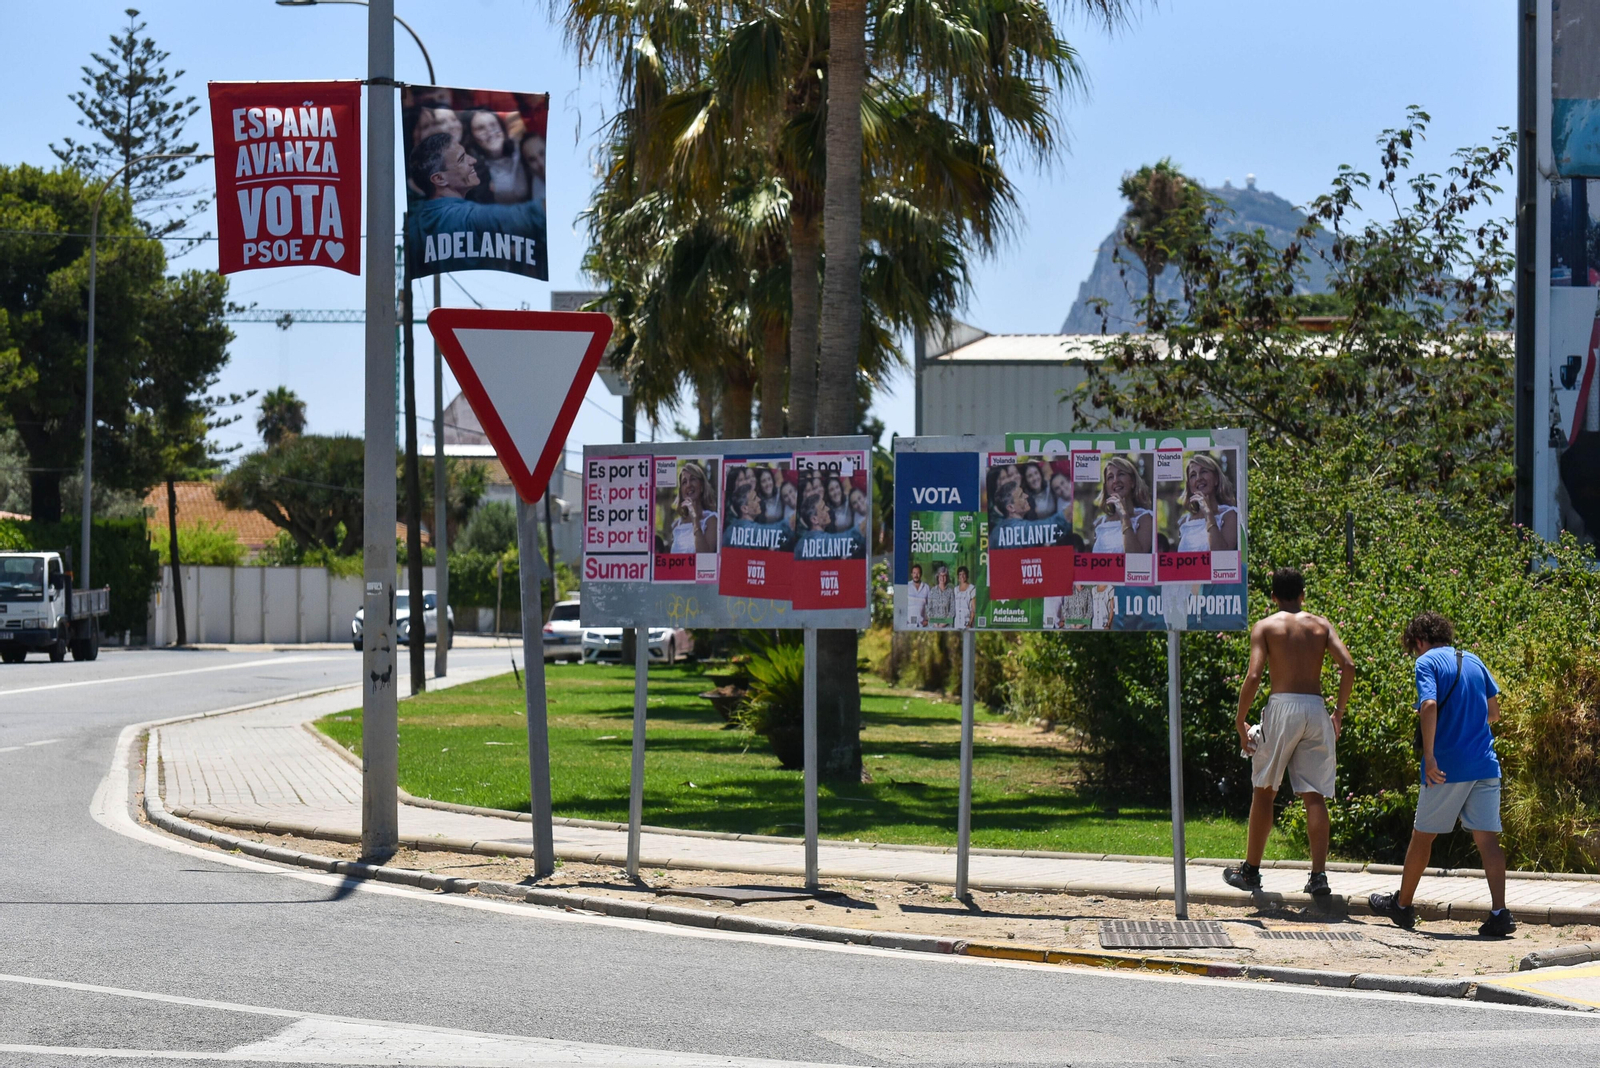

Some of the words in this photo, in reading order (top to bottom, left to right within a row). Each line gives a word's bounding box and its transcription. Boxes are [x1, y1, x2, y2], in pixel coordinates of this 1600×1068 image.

[232, 100, 337, 142] ESPAÑA
[235, 140, 339, 178] AVANZA
[237, 184, 344, 239] VOTA
[243, 239, 303, 265] PSOE
[424, 231, 537, 266] ADELANTE
[588, 462, 605, 478] Es
[609, 464, 634, 482] por
[638, 460, 649, 478] ti
[818, 461, 842, 471] po
[608, 486, 634, 504] por
[638, 482, 649, 500] ti
[912, 487, 962, 504] VOTA
[588, 505, 605, 522] Es
[608, 507, 634, 526] por
[637, 504, 648, 522] ti
[911, 520, 924, 531] EL
[587, 527, 604, 544] Es
[608, 529, 633, 548] por
[637, 526, 648, 544] ti
[730, 526, 783, 549] ADELANTE
[911, 531, 956, 542] PARTIDO
[998, 524, 1058, 547] ADELANTE
[802, 537, 854, 558] ADELANTE
[911, 542, 959, 553] ANDALUZ
[585, 557, 649, 580] Sumar
[655, 555, 667, 567] Es
[668, 557, 686, 569] por
[686, 555, 695, 567] ti
[1073, 555, 1088, 567] Es
[1090, 557, 1112, 569] por
[1115, 554, 1124, 568] ti
[1159, 554, 1173, 566] Es
[1177, 556, 1199, 569] por
[1201, 553, 1210, 566] ti
[747, 565, 765, 579] VOTA
[1021, 564, 1043, 578] VOTA
[1126, 573, 1150, 582] Sumar
[1213, 570, 1237, 579] Sumar
[820, 576, 839, 590] VOTA
[1126, 595, 1143, 616] LO
[1147, 595, 1164, 616] QU
[1186, 594, 1242, 616] MPORTA
[993, 615, 1028, 623] Andalucía
